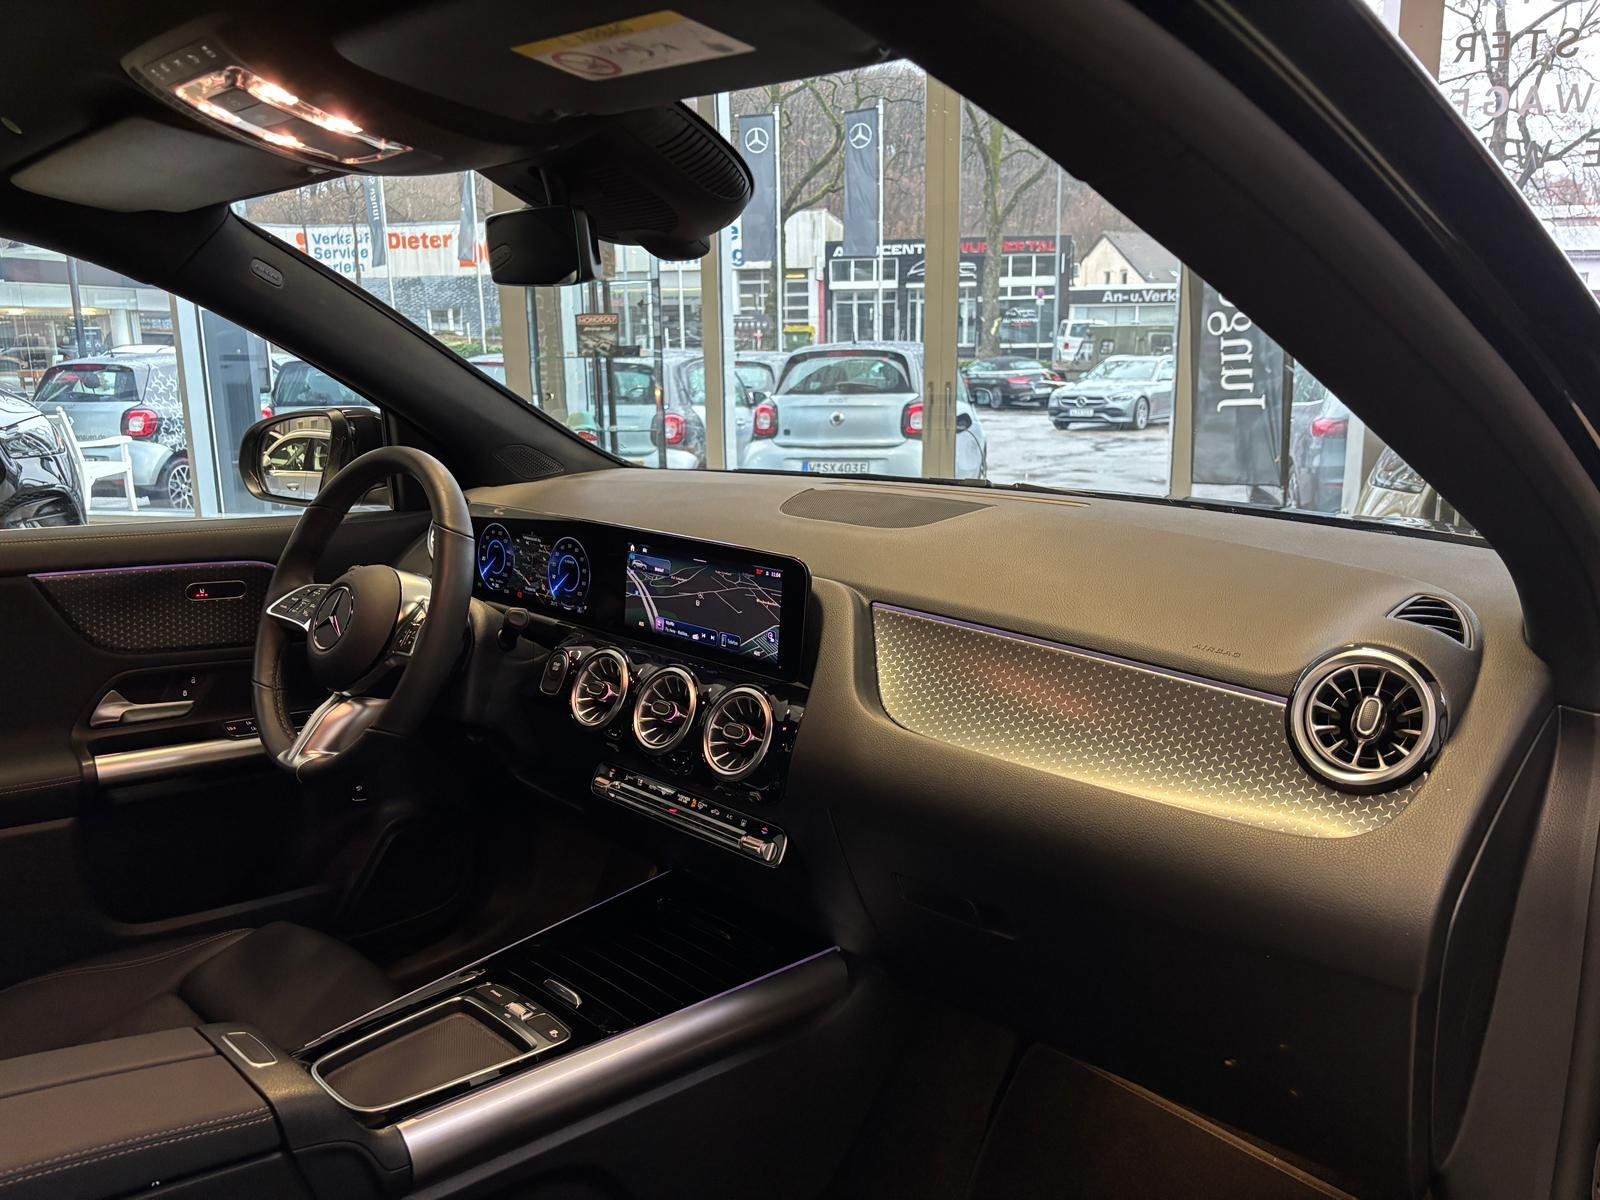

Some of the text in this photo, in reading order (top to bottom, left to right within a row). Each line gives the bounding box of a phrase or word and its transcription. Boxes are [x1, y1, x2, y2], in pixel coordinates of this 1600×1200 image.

[311, 232, 370, 245] Verkauf
[387, 232, 453, 250] Dieter
[314, 247, 369, 260] Service
